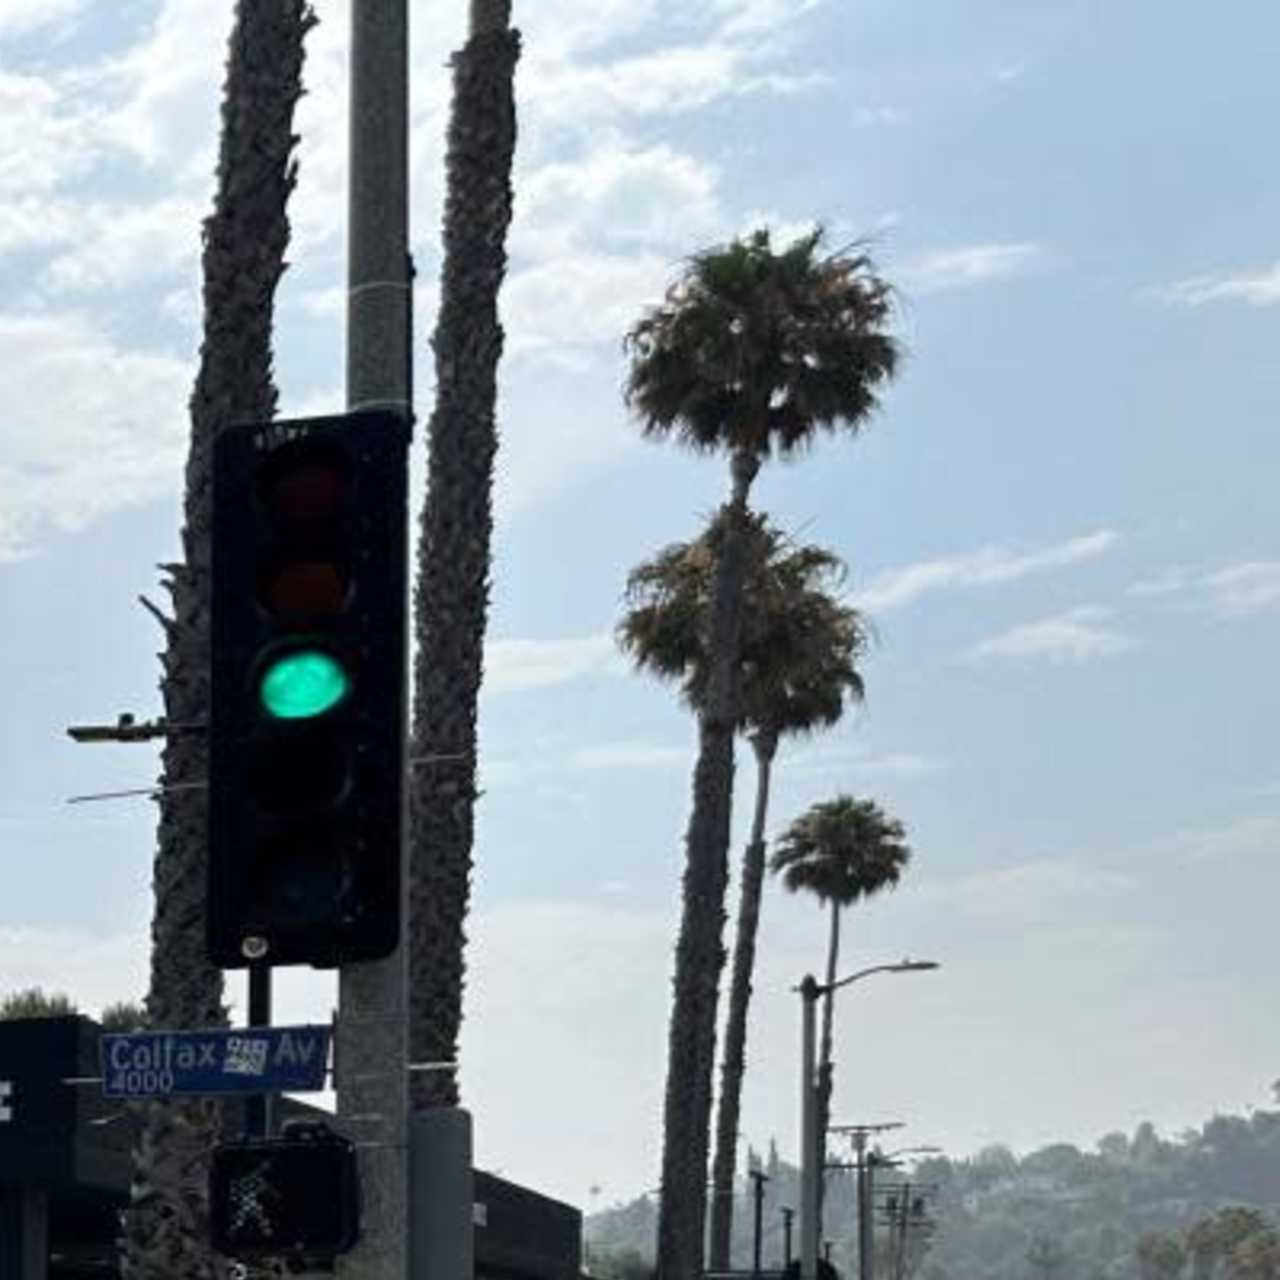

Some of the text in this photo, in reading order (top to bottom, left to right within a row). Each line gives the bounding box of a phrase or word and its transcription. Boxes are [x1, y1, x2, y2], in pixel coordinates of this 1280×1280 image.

[110, 1037, 216, 1071] Colfax
[273, 1032, 315, 1065] Av
[110, 1070, 174, 1094] 4000
